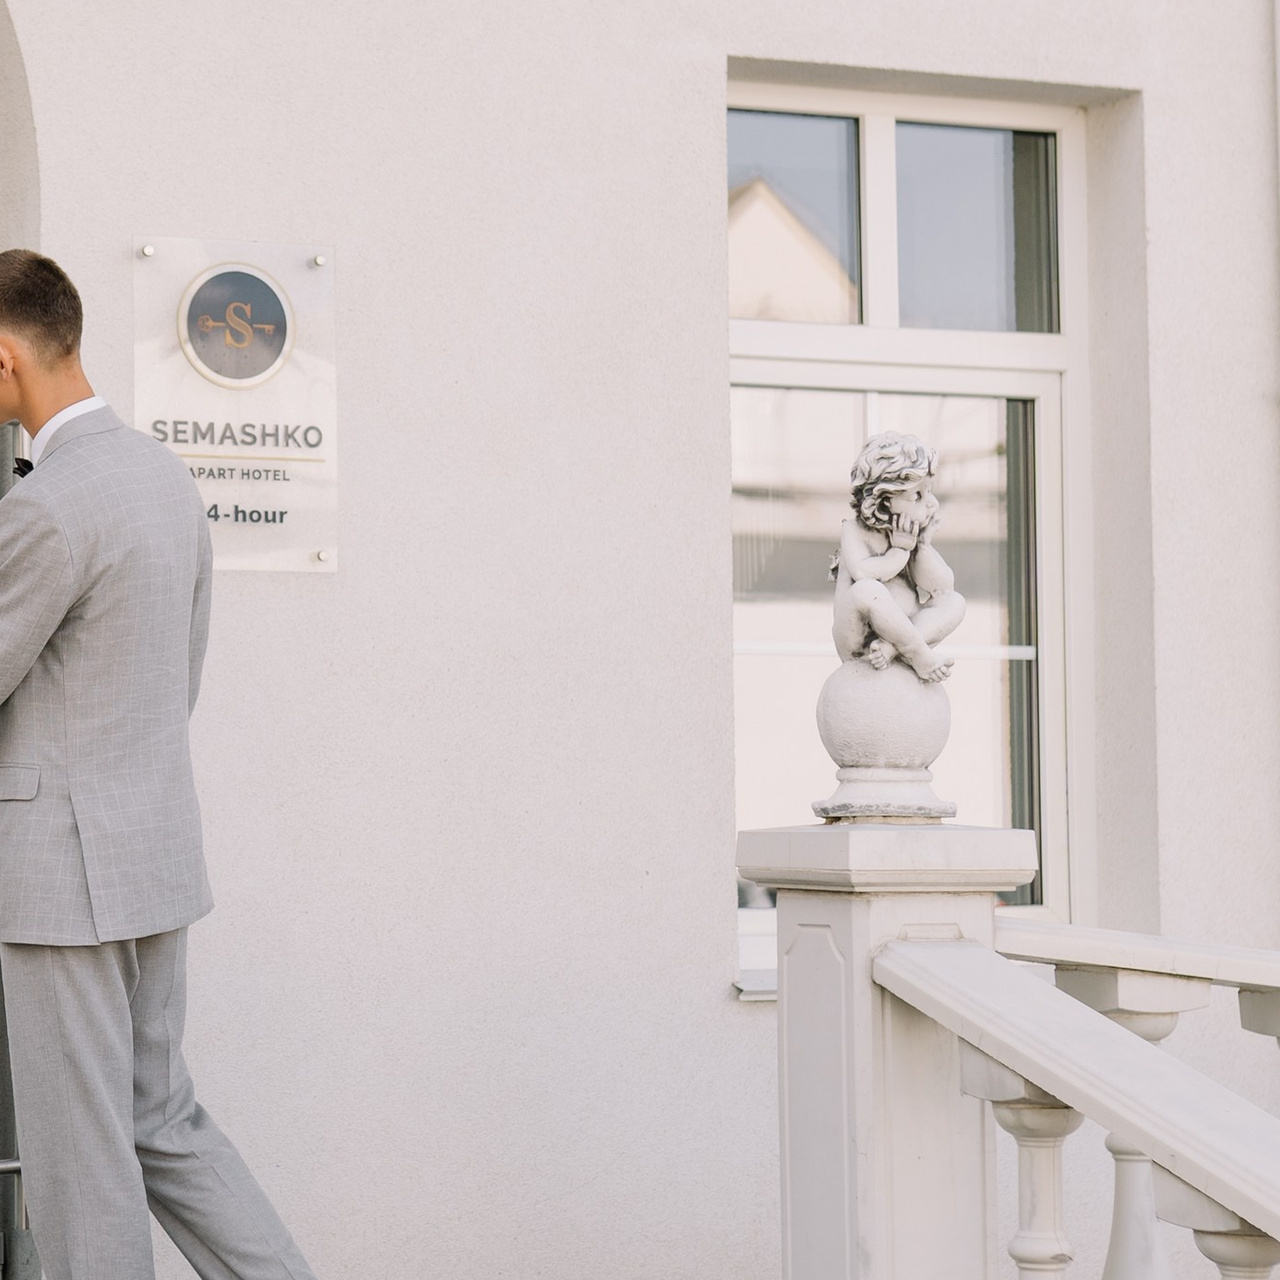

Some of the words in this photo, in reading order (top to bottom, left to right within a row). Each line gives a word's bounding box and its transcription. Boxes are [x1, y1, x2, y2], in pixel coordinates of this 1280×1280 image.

[152, 419, 323, 448] SEMASHKO
[241, 468, 290, 481] HOTEL
[207, 503, 288, 524] 4-hour
